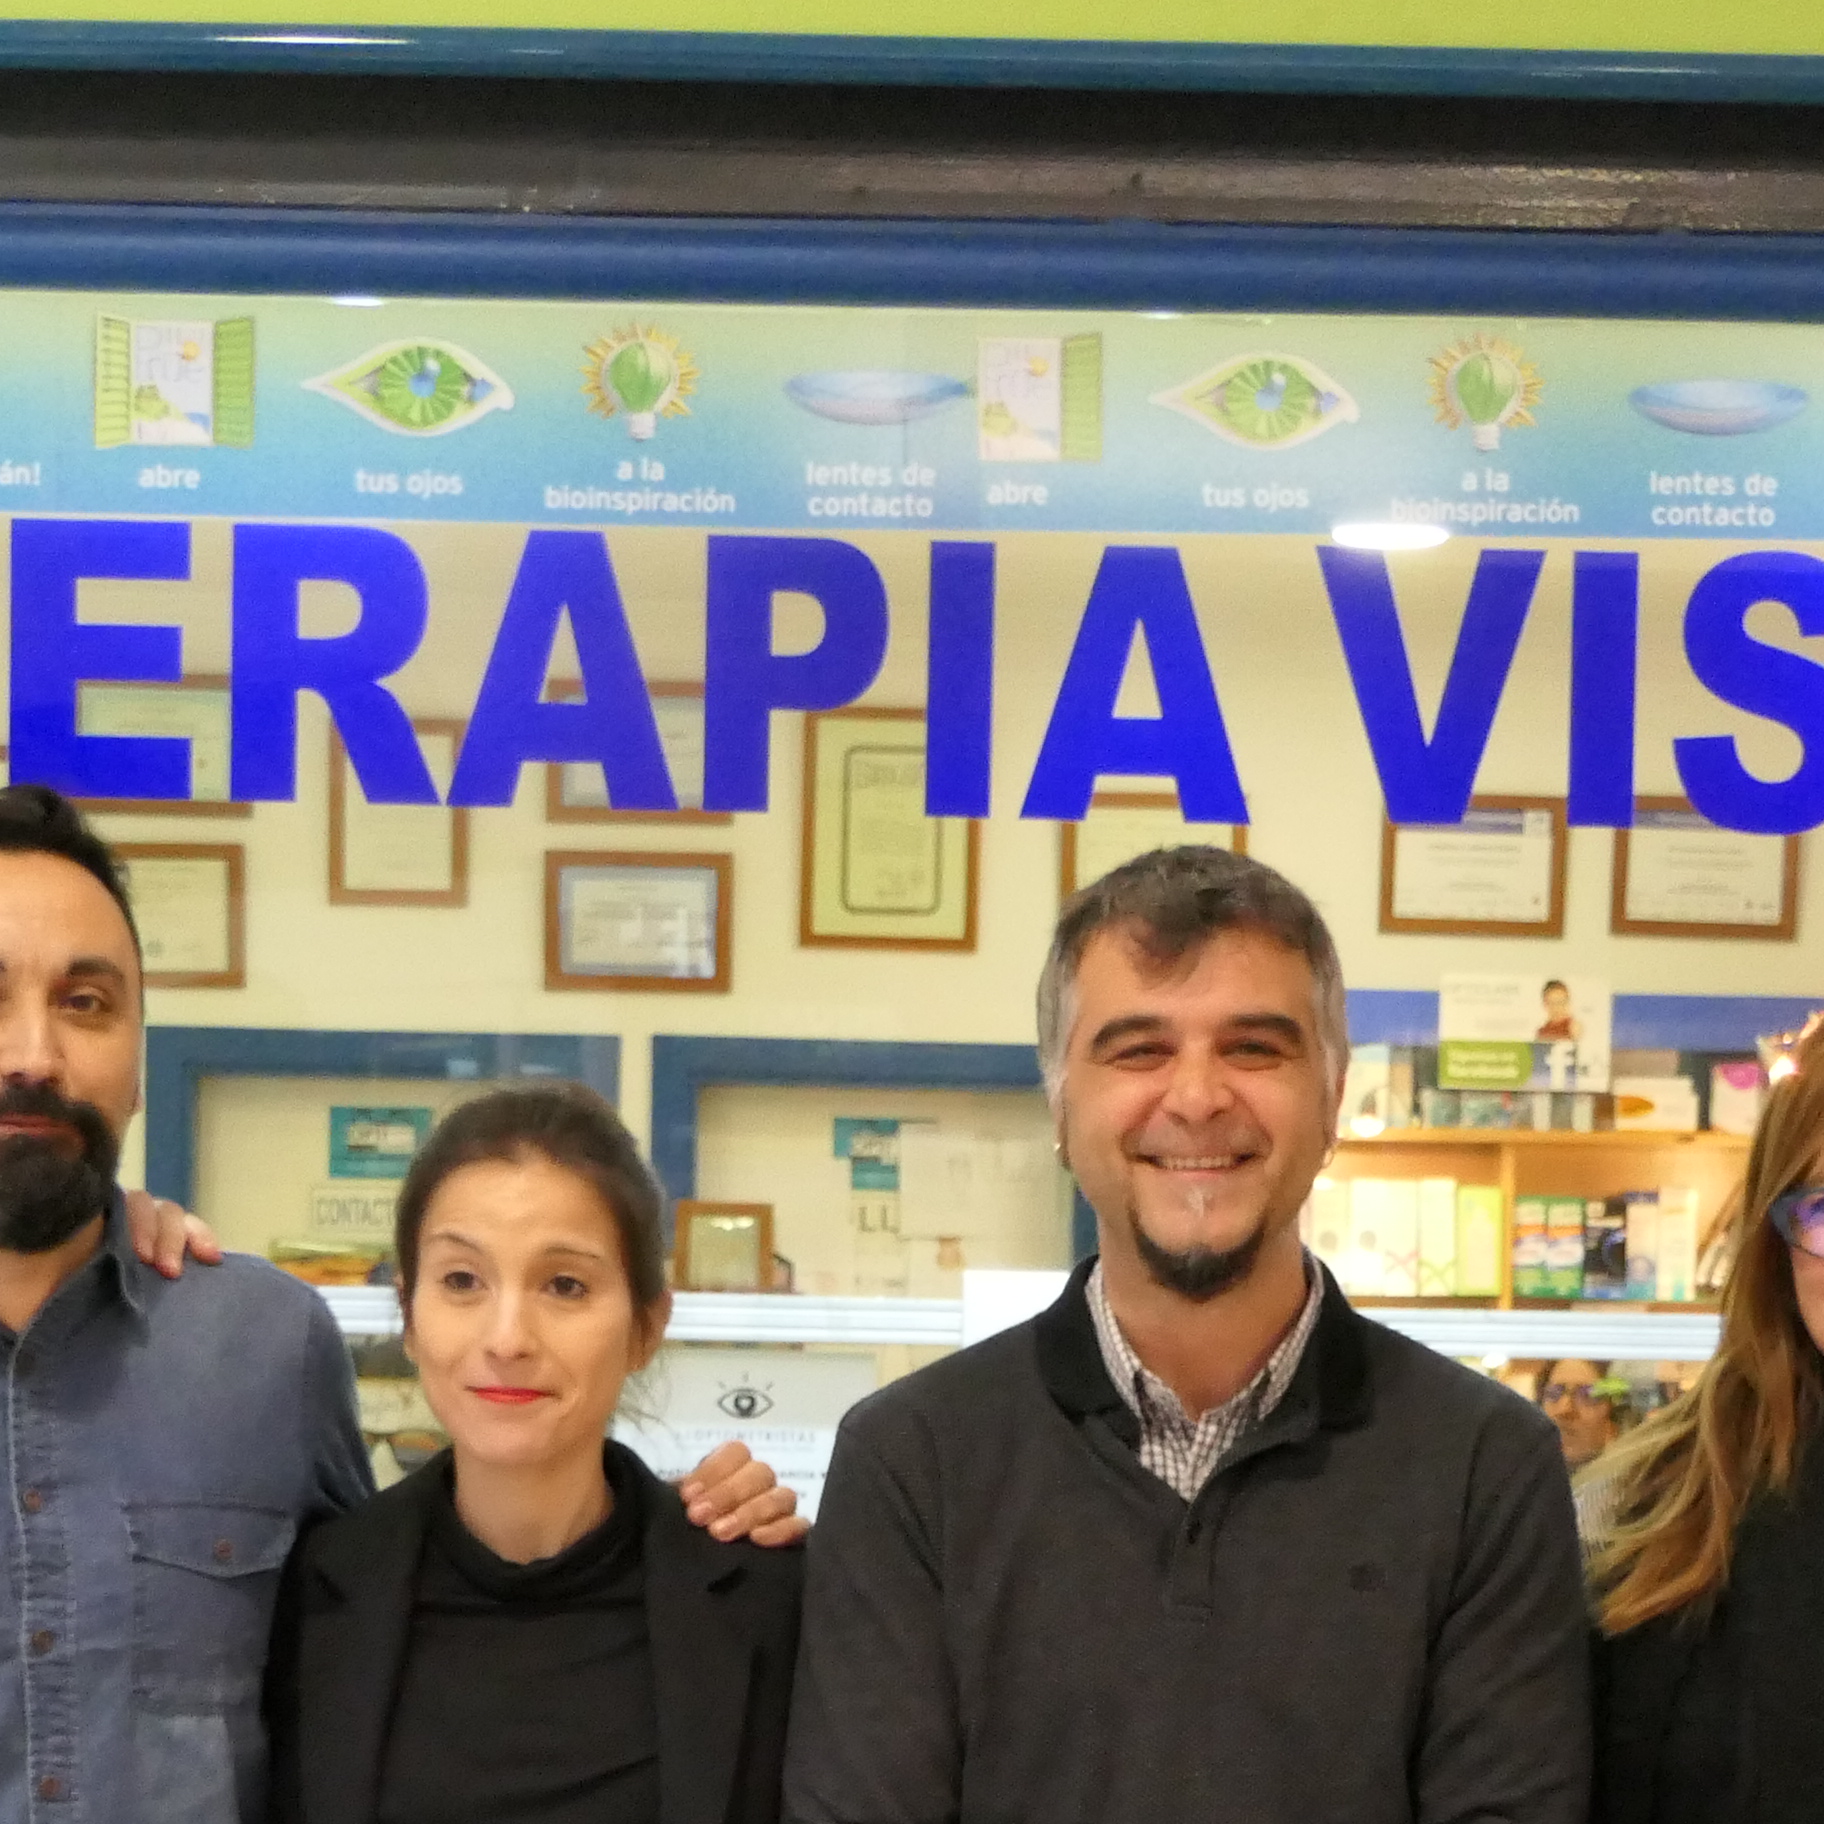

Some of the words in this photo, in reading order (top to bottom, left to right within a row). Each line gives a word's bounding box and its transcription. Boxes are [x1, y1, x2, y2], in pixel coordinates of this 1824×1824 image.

[138, 465, 200, 488] abre
[617, 462, 634, 480] a
[641, 458, 664, 481] la
[806, 462, 891, 485] lentes
[902, 462, 935, 485] de
[1463, 473, 1477, 490] a
[1486, 469, 1509, 491] la
[355, 469, 399, 493] tus
[406, 470, 463, 498] ojos
[987, 480, 1046, 504] abre
[1650, 472, 1735, 495] lentes
[1745, 474, 1777, 496] de
[544, 485, 735, 512] bioinspiración
[807, 495, 931, 516] contacto
[1203, 483, 1244, 506] tus
[1254, 483, 1308, 509] ojos
[1652, 504, 1775, 526] contacto
